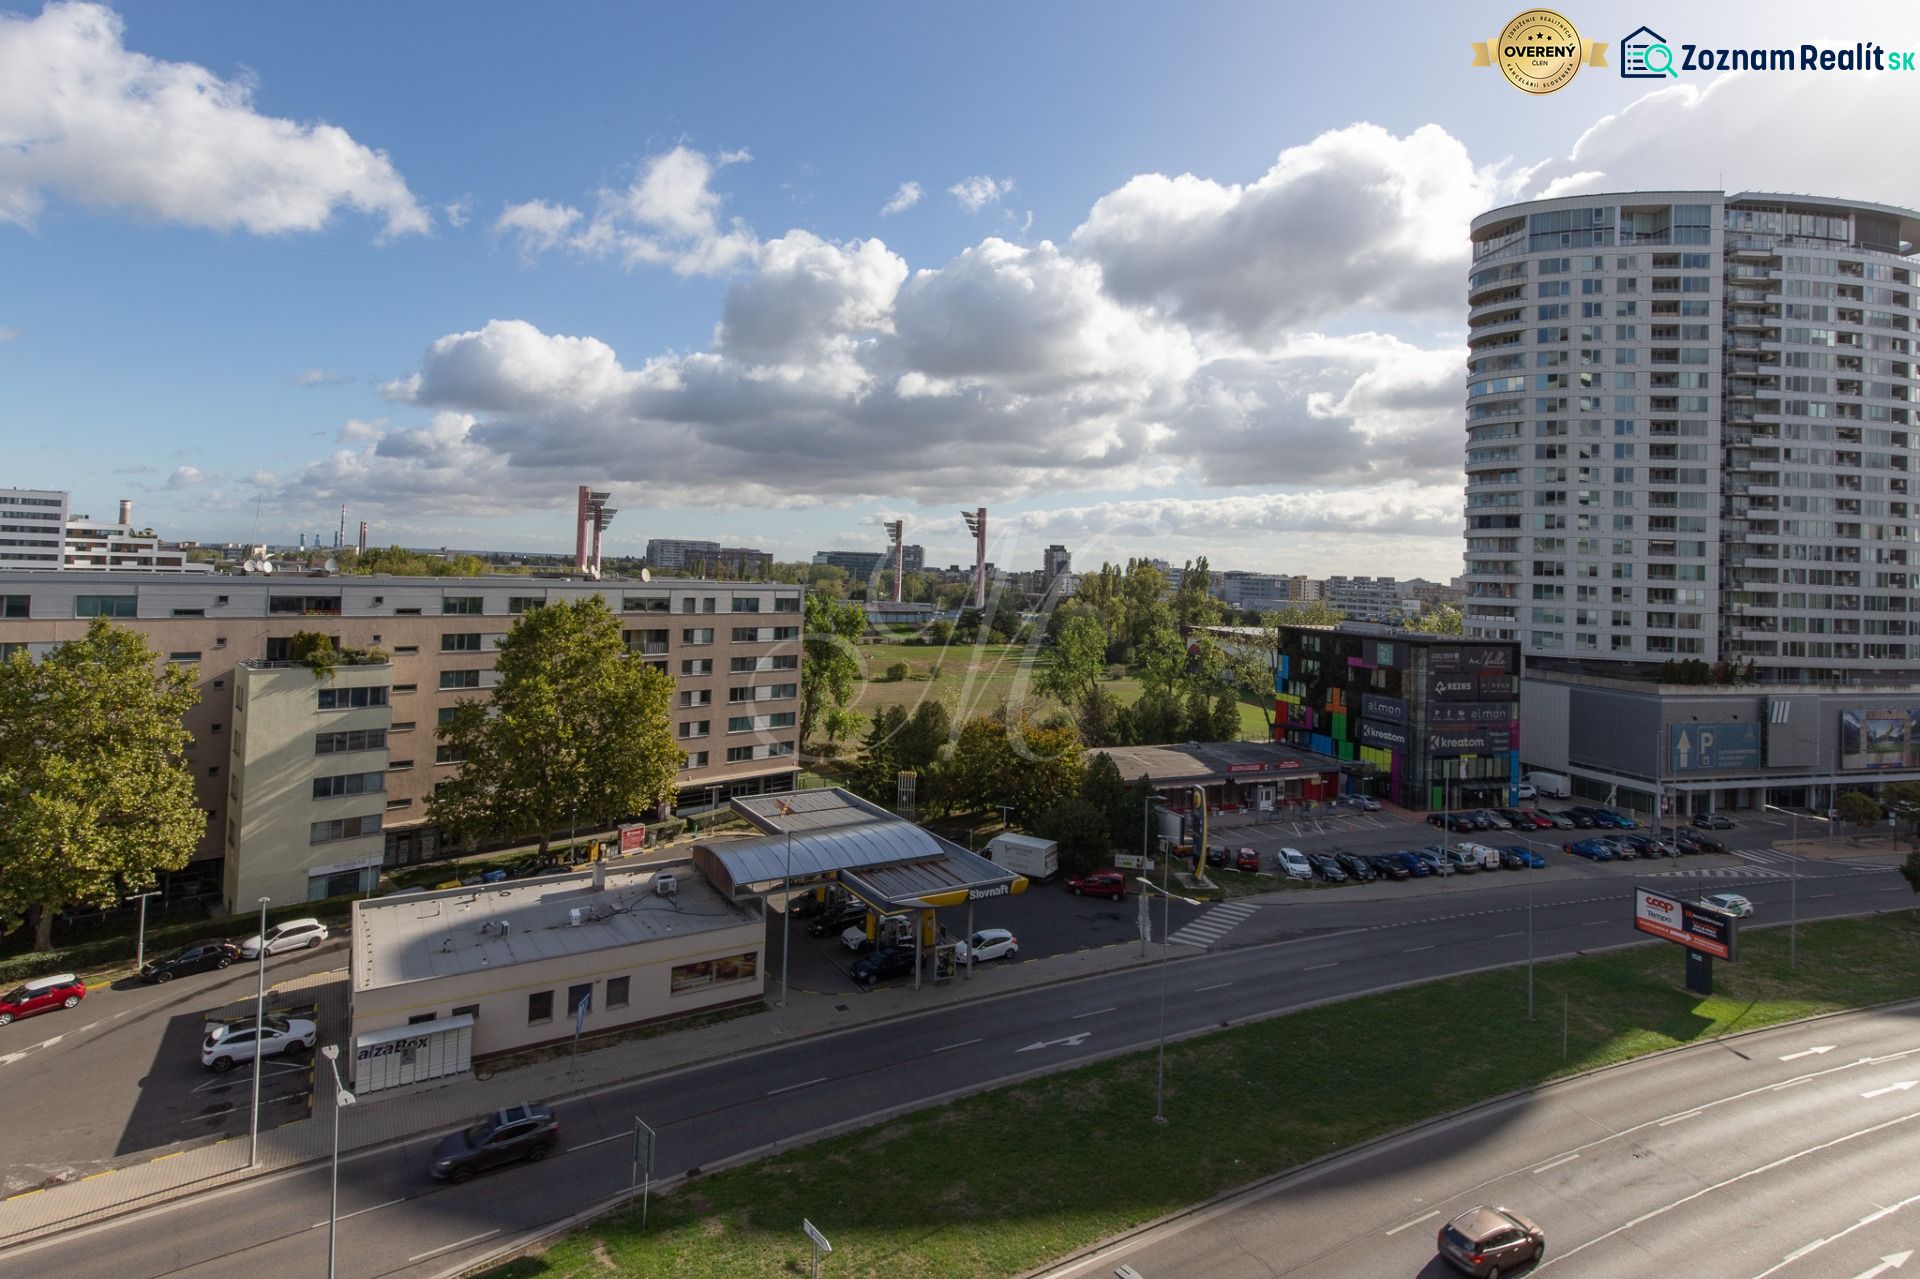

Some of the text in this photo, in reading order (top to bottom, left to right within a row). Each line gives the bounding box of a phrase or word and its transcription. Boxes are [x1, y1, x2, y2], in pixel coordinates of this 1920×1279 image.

[1368, 701, 1401, 715] almon
[1471, 708, 1506, 718] almon
[1371, 726, 1405, 743] kreatom
[1441, 736, 1485, 748] kreatom
[1701, 733, 1714, 754] P
[969, 885, 1008, 900] Slovnaft
[1645, 896, 1674, 913] coop
[1647, 910, 1672, 923] Tempo
[357, 1037, 428, 1060] alzaBox
